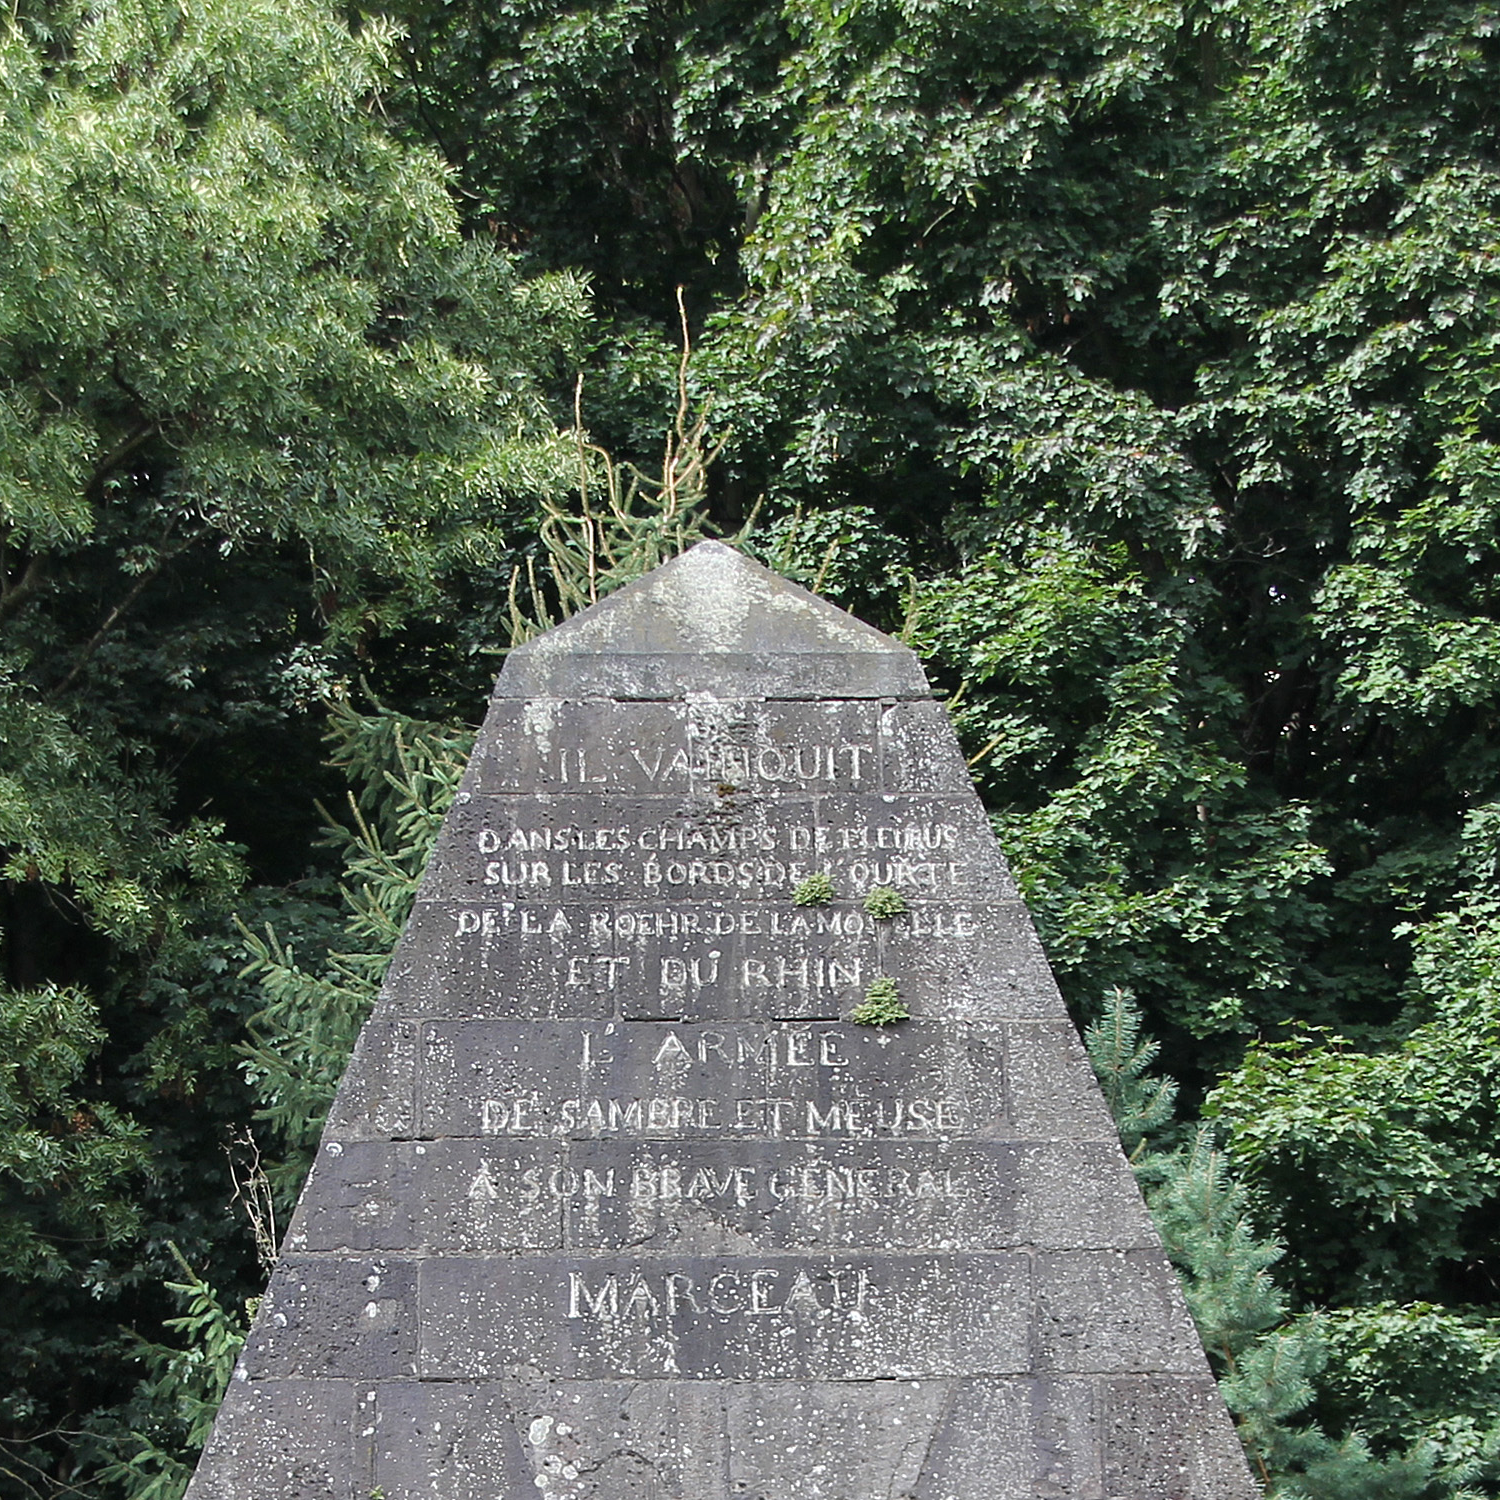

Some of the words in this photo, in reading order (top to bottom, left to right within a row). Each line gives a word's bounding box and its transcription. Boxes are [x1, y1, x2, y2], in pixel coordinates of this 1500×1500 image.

[559, 747, 607, 784] IL
[478, 827, 571, 853] DANS
[576, 828, 631, 851] LES
[638, 826, 776, 851] CHAMPS
[789, 827, 833, 851] DE
[838, 825, 959, 851] FLEURUS
[483, 861, 552, 886] SUR
[562, 860, 623, 886] LES
[642, 861, 754, 887] BORDS
[763, 861, 807, 886] DE
[455, 909, 501, 937] DE
[520, 908, 573, 935] LA
[712, 911, 762, 936] DE
[771, 912, 812, 935] LA
[566, 956, 630, 989] ET
[661, 957, 719, 987] DU
[743, 957, 864, 989] RHIN
[481, 1099, 534, 1131] DE
[560, 1099, 722, 1132] SAMBRE
[734, 1099, 794, 1132] ET
[806, 1099, 964, 1134] MEUSE
[520, 1166, 615, 1199] SON
[631, 1165, 757, 1199] BRAVE
[567, 1268, 872, 1319] MARCEAU
